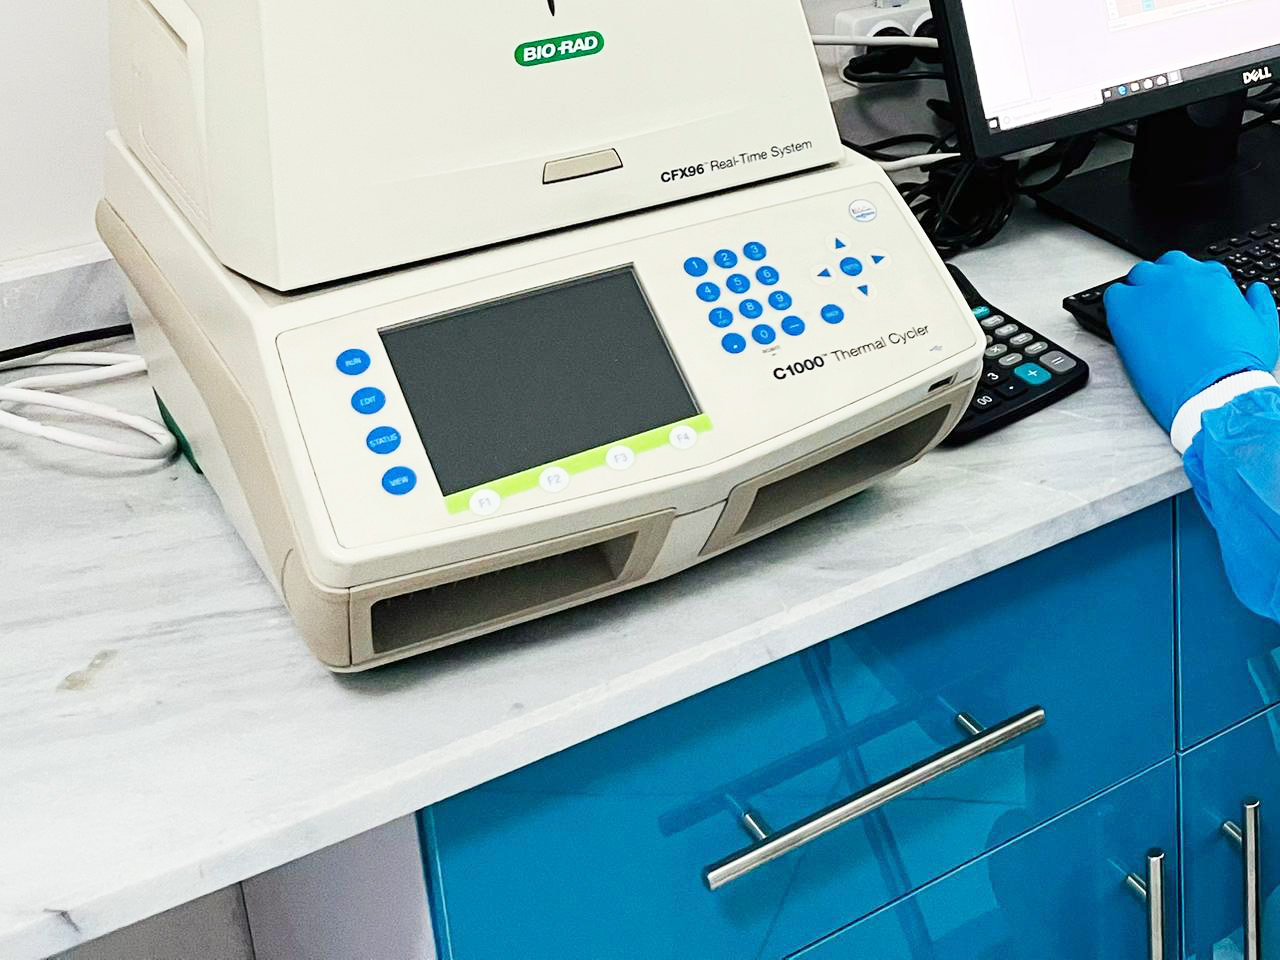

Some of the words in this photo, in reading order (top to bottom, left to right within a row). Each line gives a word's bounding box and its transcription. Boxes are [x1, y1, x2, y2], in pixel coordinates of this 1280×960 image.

[1243, 66, 1272, 84] DELL
[710, 150, 768, 172] Real-Time
[770, 139, 813, 160] System
[750, 244, 759, 253] 3
[721, 253, 729, 262] 2
[692, 260, 698, 269] 1
[763, 269, 771, 278] 6
[734, 277, 742, 286] 5
[704, 285, 712, 293] 4
[775, 293, 784, 302] 9
[746, 302, 755, 311] 8
[716, 311, 722, 320] 7
[831, 339, 886, 362] Thermal
[888, 325, 929, 345] Cycler
[360, 395, 377, 406] EDIT
[369, 432, 398, 448] STATUS
[676, 431, 690, 443] F4
[614, 452, 628, 464] F3
[389, 475, 409, 487] VIEW
[547, 474, 561, 486] F2
[478, 496, 493, 509] F1
